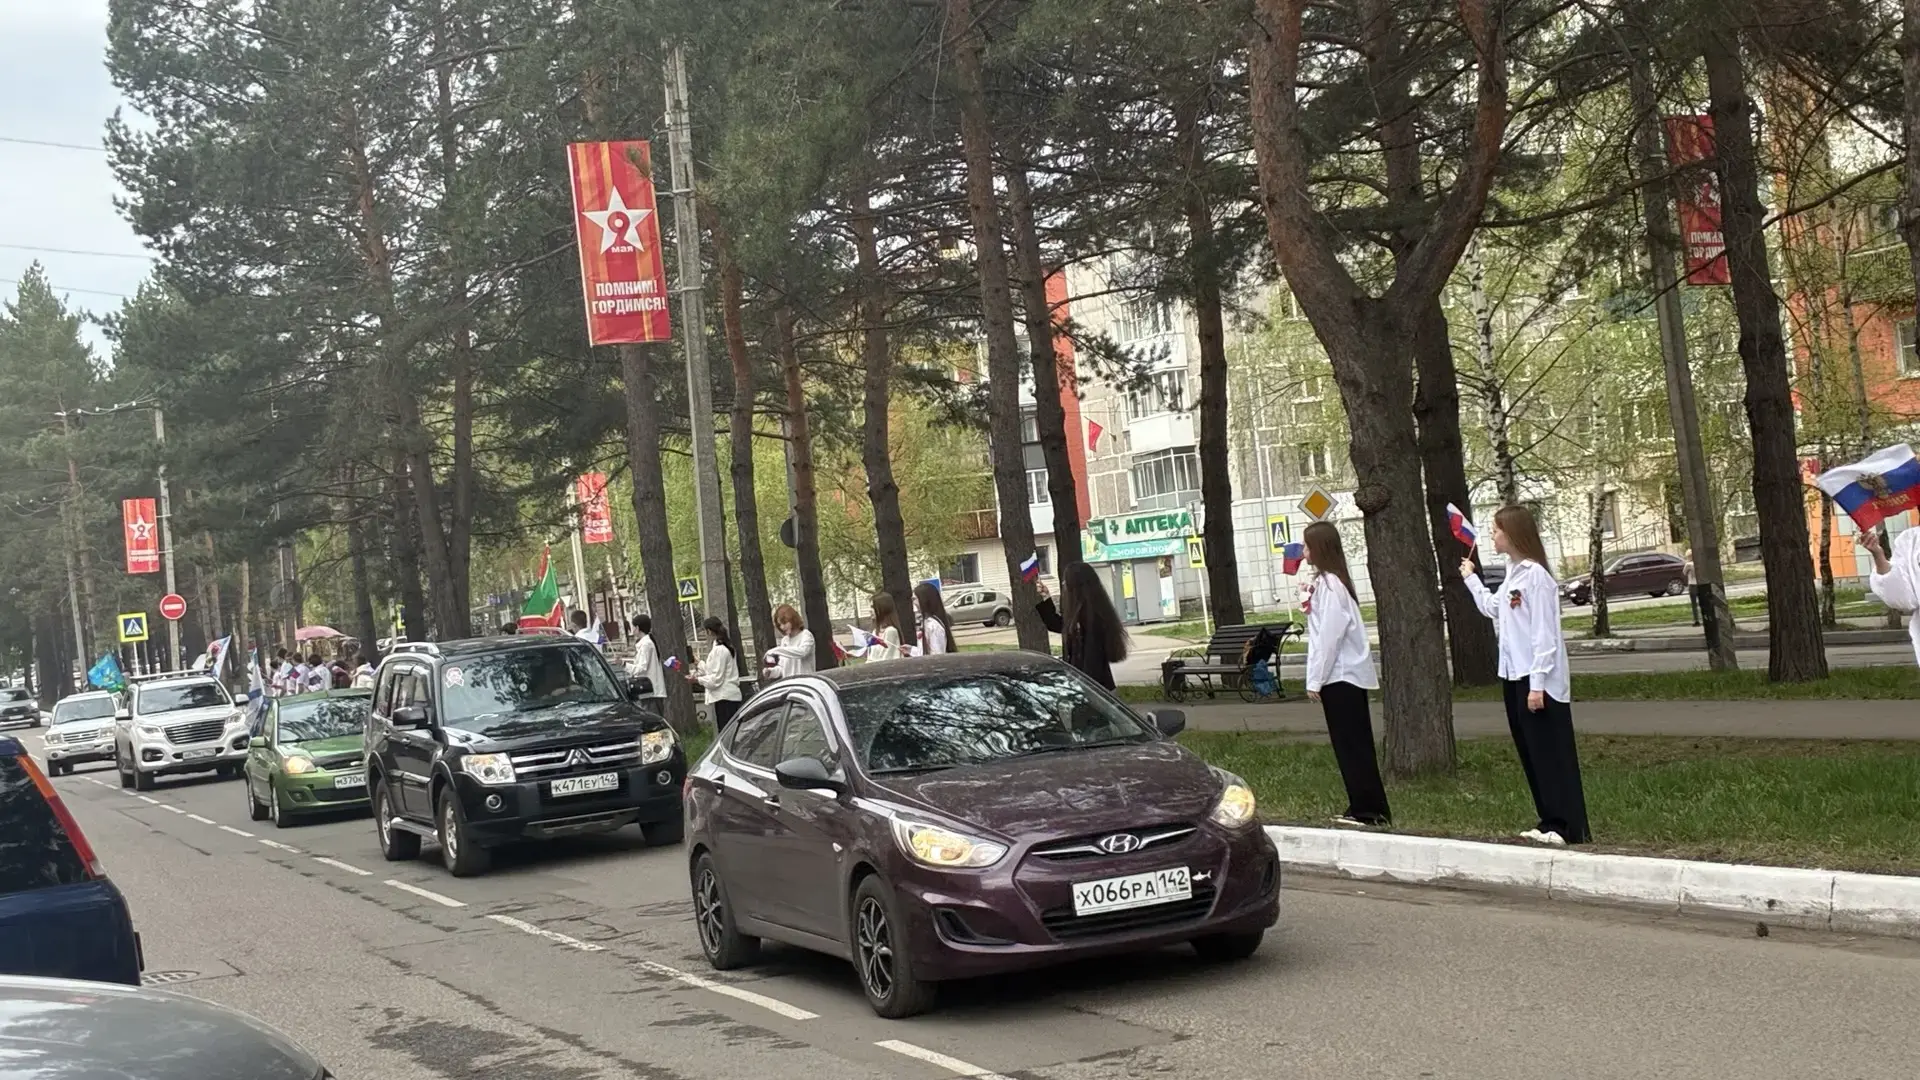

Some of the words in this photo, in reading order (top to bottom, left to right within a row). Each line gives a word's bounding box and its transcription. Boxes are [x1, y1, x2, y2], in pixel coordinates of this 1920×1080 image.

[607, 211, 630, 247] 9
[611, 245, 633, 253] мая
[595, 280, 658, 297] ПОМНИМ!
[591, 297, 667, 315] ГОРДИМСЯ!
[1125, 511, 1192, 535] АПТЕКА
[1080, 880, 1156, 907] Х066РА
[1158, 871, 1186, 888] 142
